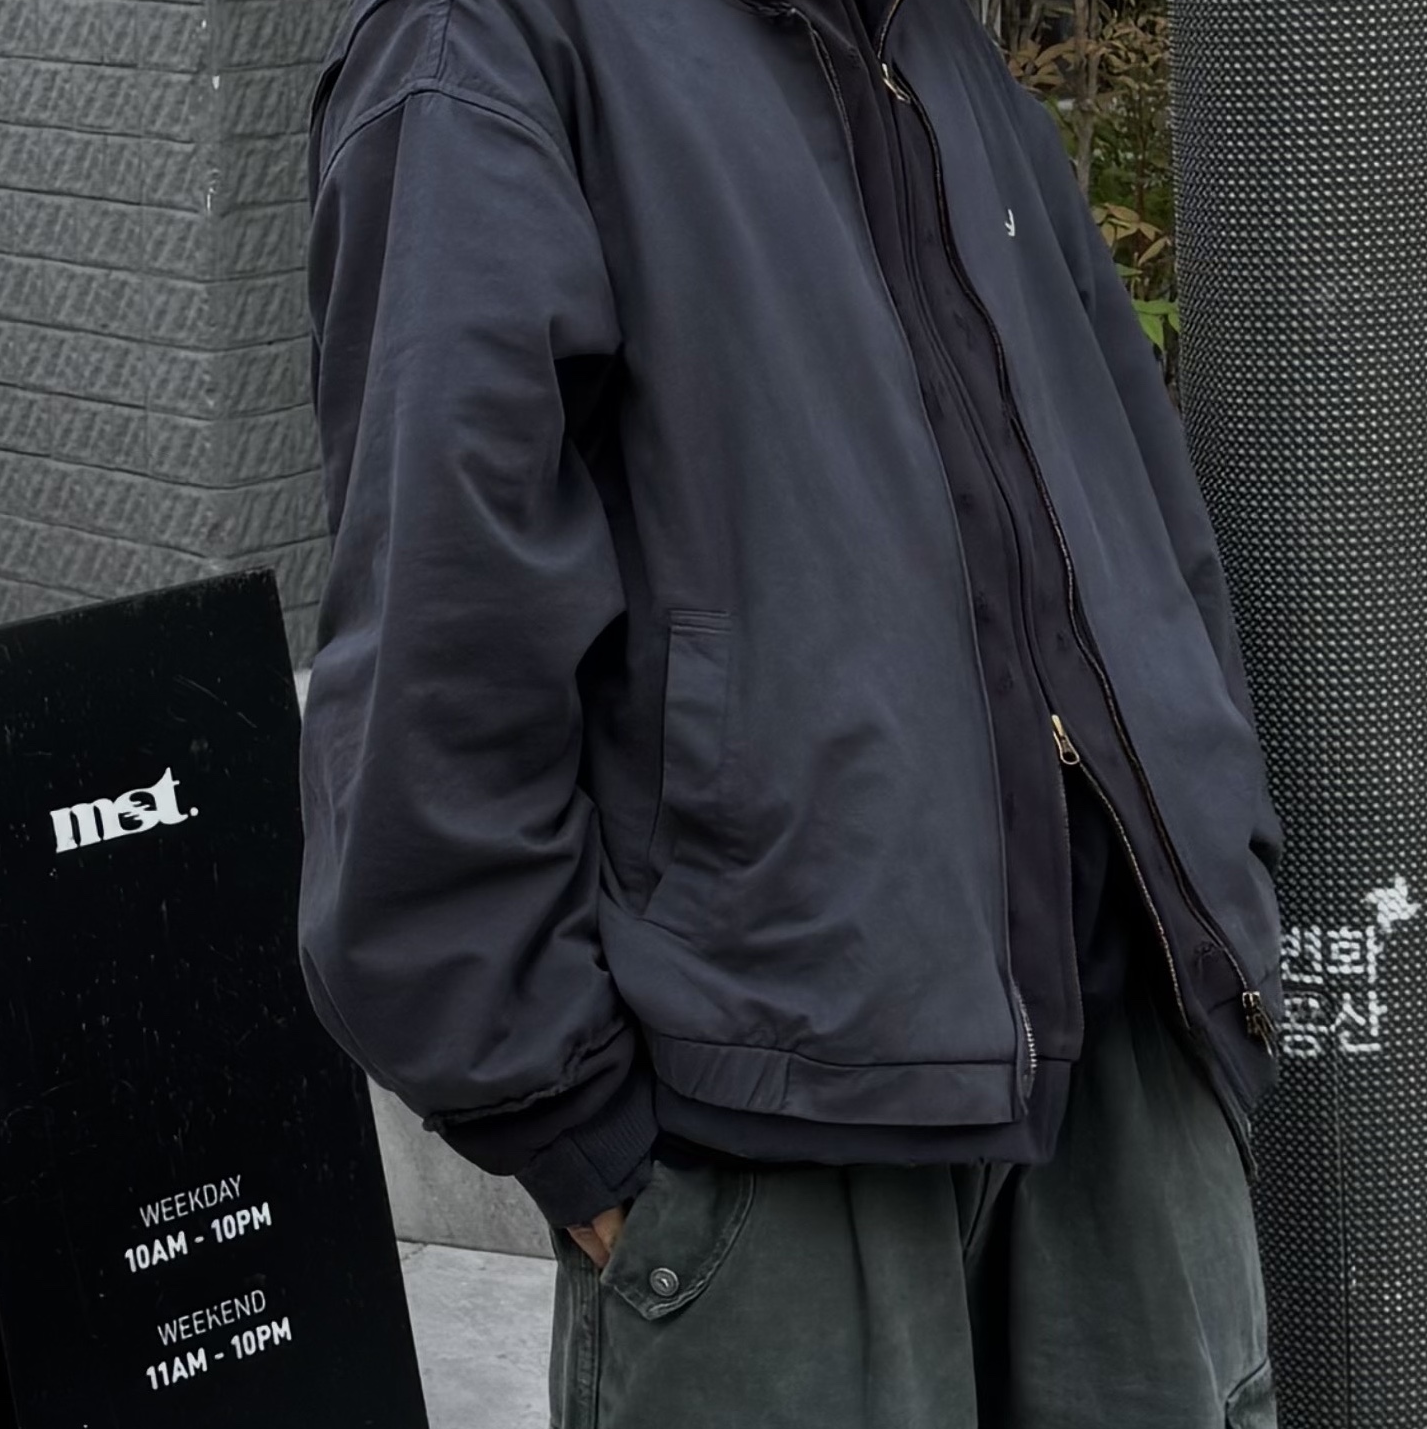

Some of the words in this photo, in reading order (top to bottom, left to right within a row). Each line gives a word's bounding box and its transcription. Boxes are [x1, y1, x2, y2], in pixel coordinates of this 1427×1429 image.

[139, 1174, 242, 1228] WEEKDAY
[124, 1230, 189, 1273] 10AM
[210, 1201, 273, 1244] 10PM
[157, 1289, 267, 1346] WEEKEND
[146, 1347, 208, 1391] 11AM
[230, 1316, 292, 1360] 10PM
